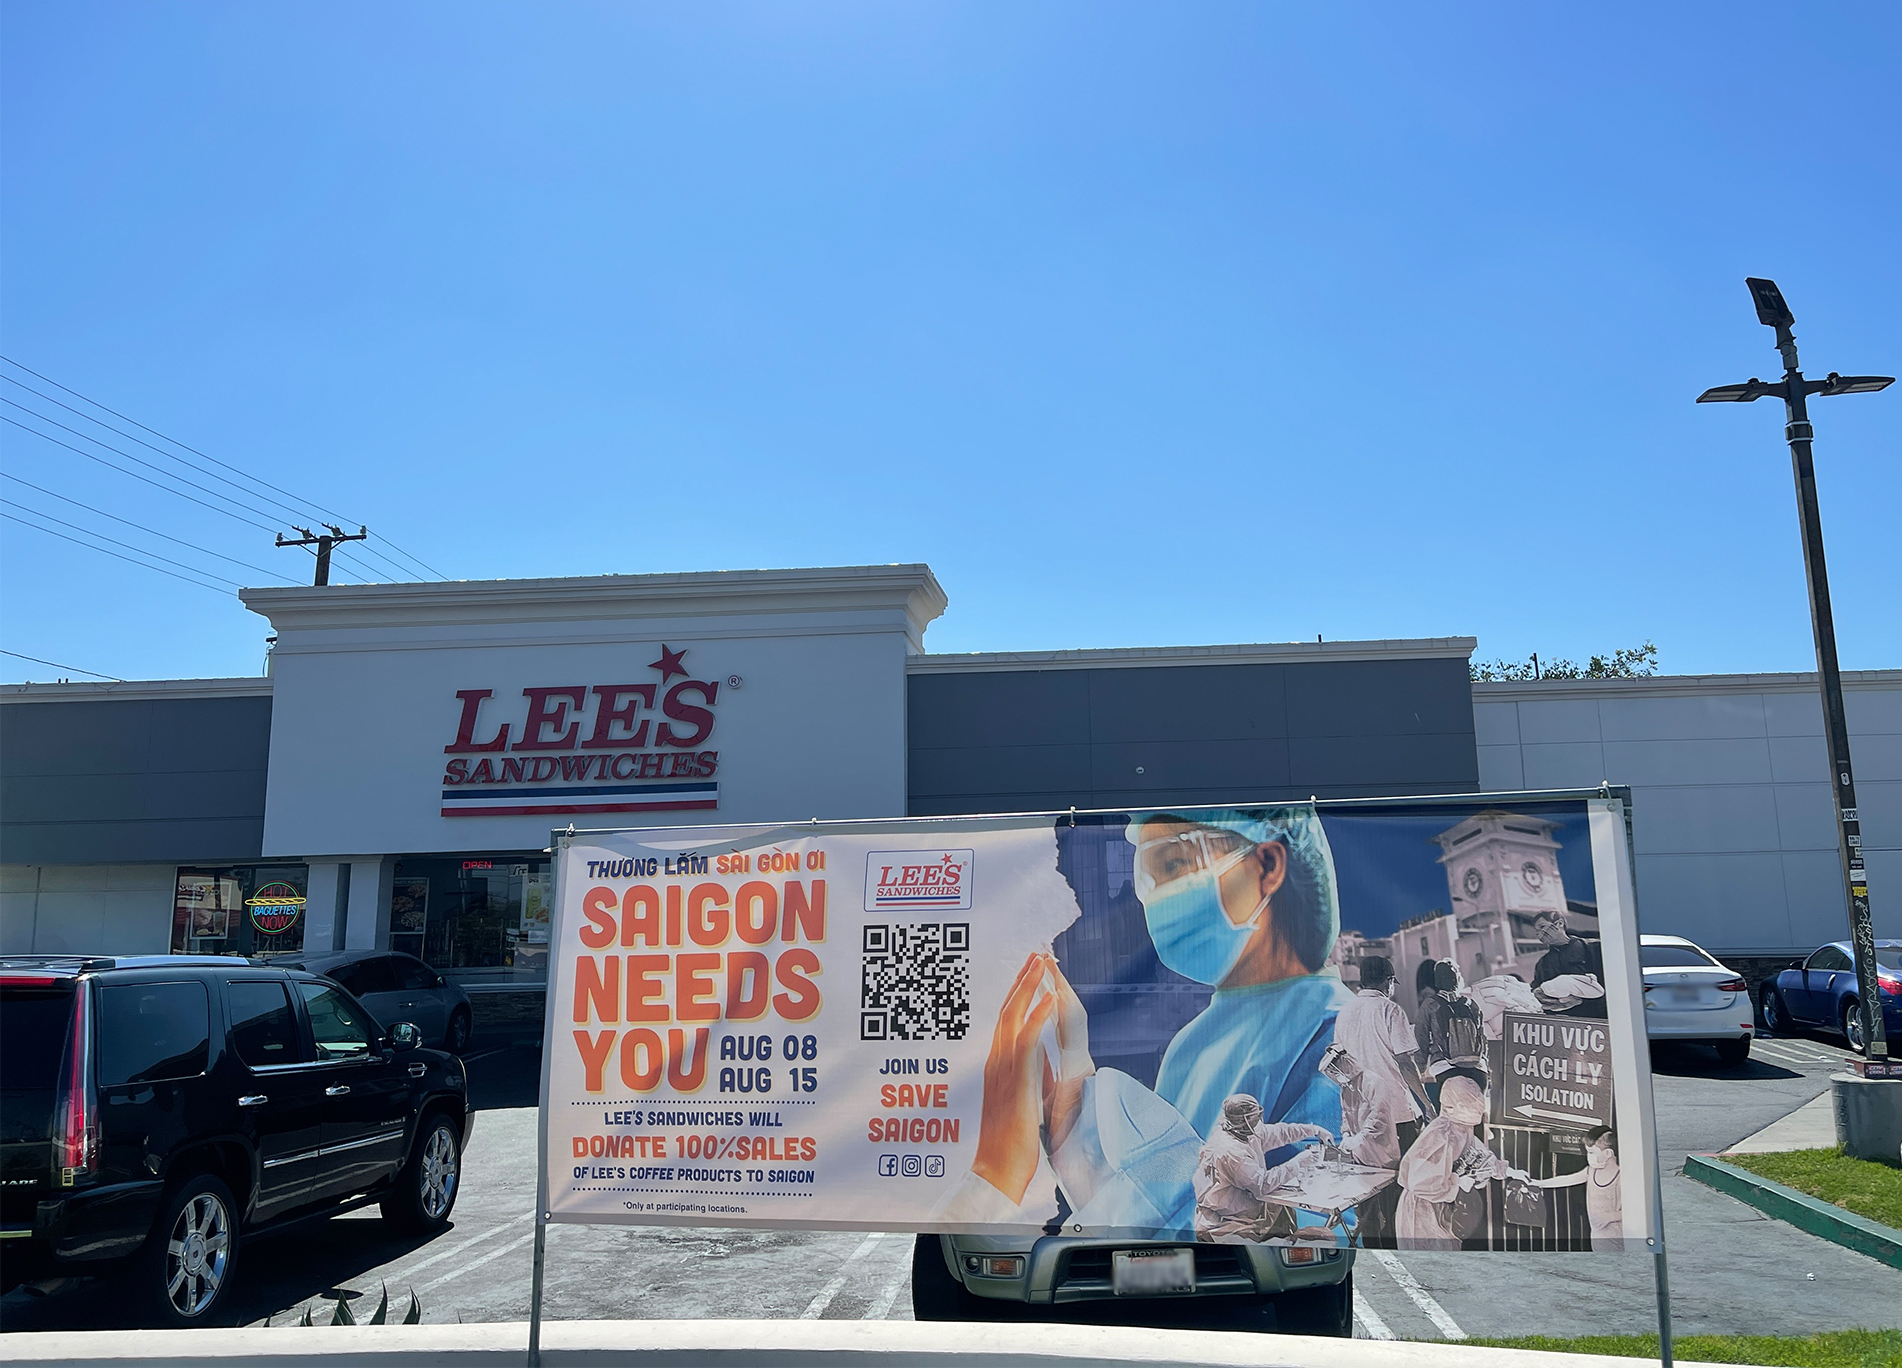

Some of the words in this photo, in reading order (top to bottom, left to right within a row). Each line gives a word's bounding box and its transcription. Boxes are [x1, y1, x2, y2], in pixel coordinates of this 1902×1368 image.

[442, 750, 719, 785] SANDWICHES
[462, 861, 492, 869] OPEN
[587, 857, 659, 879] THƯƠNG
[664, 852, 710, 876] LẮM
[716, 848, 751, 875] SÀI
[757, 846, 800, 873] GÒN
[264, 885, 288, 898] HOT
[876, 886, 961, 896] SANDWICHES
[254, 905, 297, 916] BAGUETTES
[261, 916, 289, 930] NOW
[578, 879, 828, 950] SAIGON
[572, 948, 823, 1026] NEEDS
[720, 1034, 772, 1060] AUG
[783, 1034, 818, 1060] 08
[1513, 1022, 1554, 1047] KHU
[1561, 1024, 1605, 1055] VỰC
[572, 1028, 711, 1094] YOU
[880, 1058, 919, 1074] JOIN
[926, 1058, 949, 1074] US
[1513, 1049, 1567, 1081] CÁCH
[1575, 1061, 1603, 1085] LY
[720, 1067, 772, 1093] AUG
[789, 1067, 818, 1093] 15
[880, 1083, 949, 1108] SAVE
[1521, 1083, 1594, 1110] ISOLATION
[604, 1110, 643, 1126] LEE'S
[647, 1111, 743, 1126] SANDWICHES
[749, 1112, 783, 1127] WILL
[868, 1117, 960, 1143] SAIGON
[572, 1135, 666, 1159] DONATE
[573, 1166, 588, 1179] OF
[592, 1167, 625, 1179] LEE'S
[630, 1167, 674, 1180] COFFEE
[678, 1169, 742, 1183] PRODUCTS
[746, 1170, 763, 1182] TO
[768, 1170, 814, 1184] SAIGON
[656, 1202, 706, 1214] participating
[708, 1204, 748, 1213] locations.
